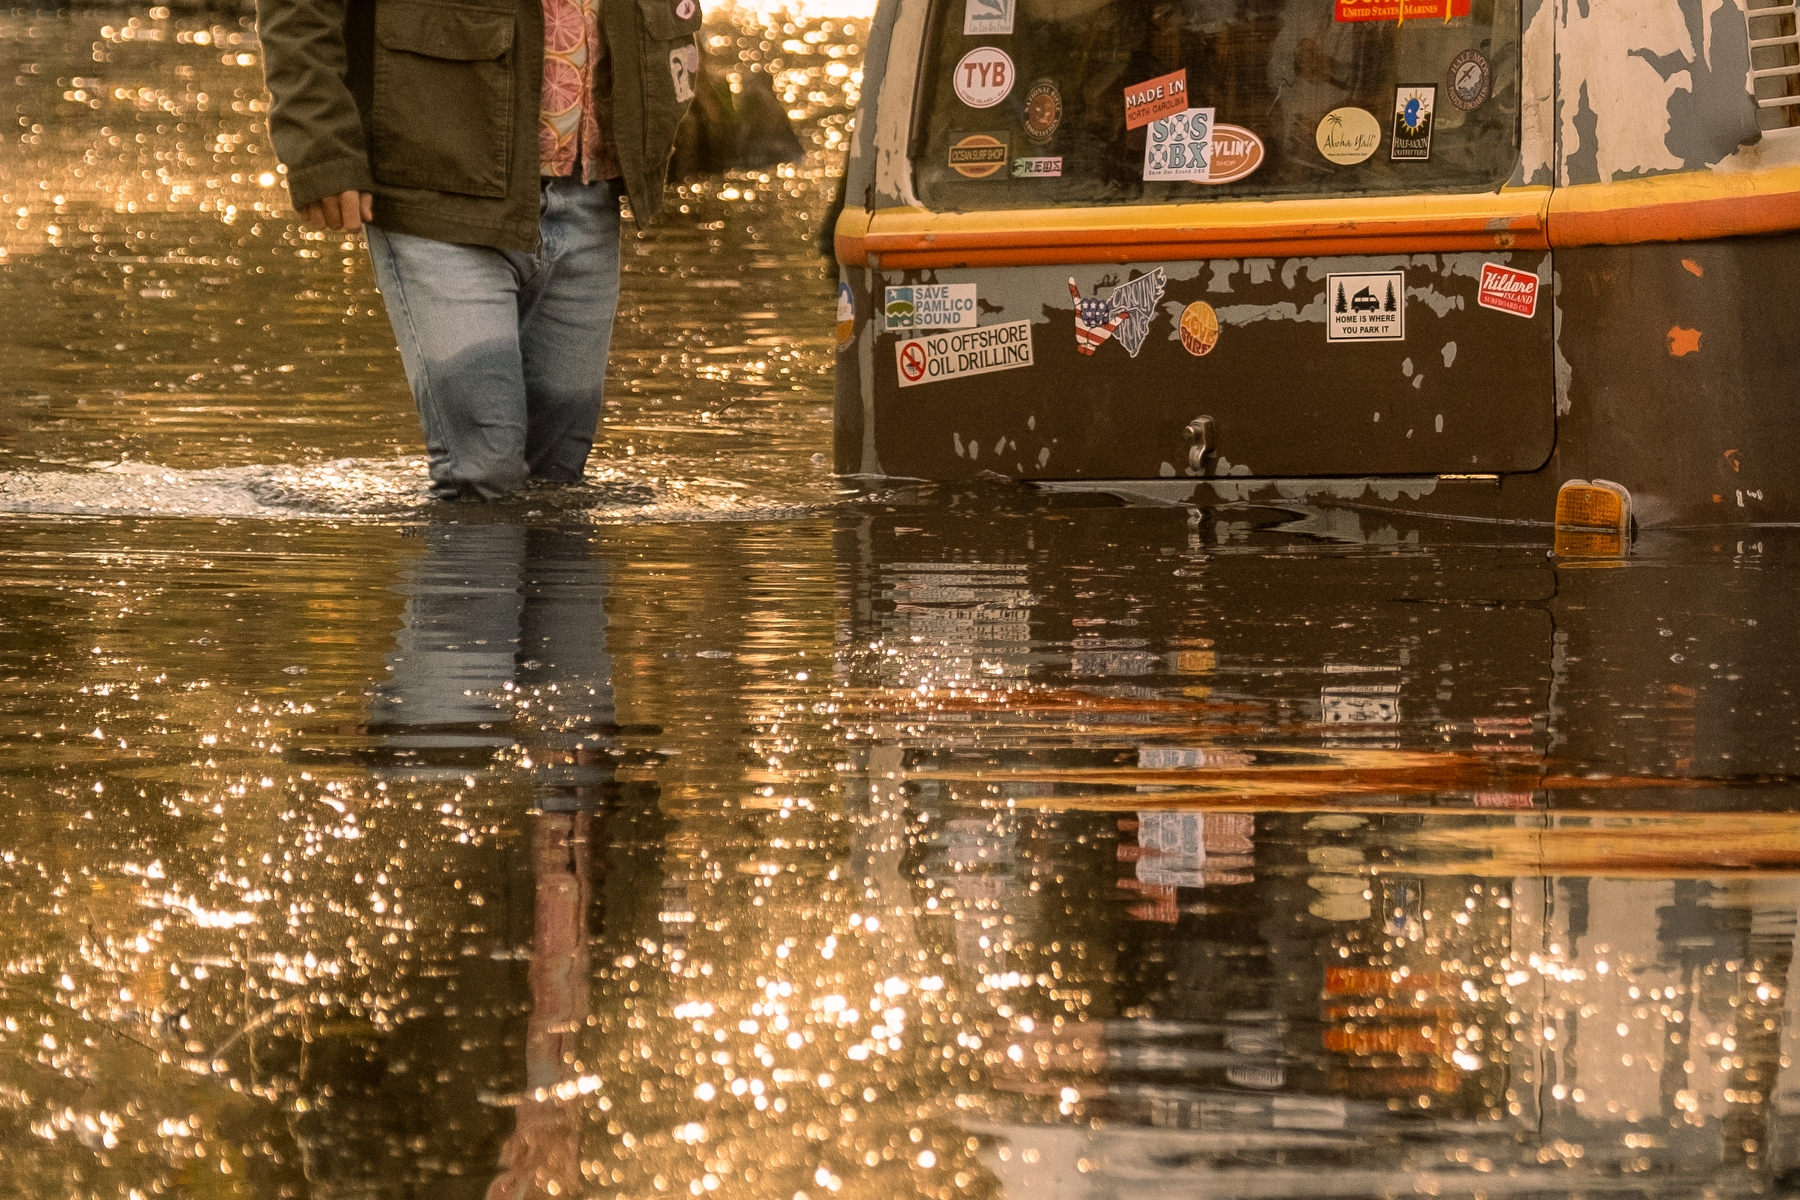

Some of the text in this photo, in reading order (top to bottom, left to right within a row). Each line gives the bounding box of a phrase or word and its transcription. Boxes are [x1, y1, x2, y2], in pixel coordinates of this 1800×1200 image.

[1342, 5, 1438, 17] UNITED STATES MARINES
[964, 62, 1005, 88] TYB
[1126, 79, 1184, 109] MADE IN
[1128, 97, 1185, 122] NORTH CAROLINA
[1152, 113, 1208, 143] SOS
[952, 149, 1003, 161] OCEAN SURF SHOP
[1148, 142, 1208, 170] OBX
[1483, 272, 1534, 293] Kildare
[915, 287, 948, 300] SAVE
[1484, 296, 1519, 310] SURFBOARD
[1503, 292, 1533, 304] ISLAND
[915, 298, 973, 312] PAMLICO
[915, 312, 961, 325] SOUND
[927, 325, 1028, 357] NO OFFSHORE
[928, 343, 1029, 376] OIL DRILLING
